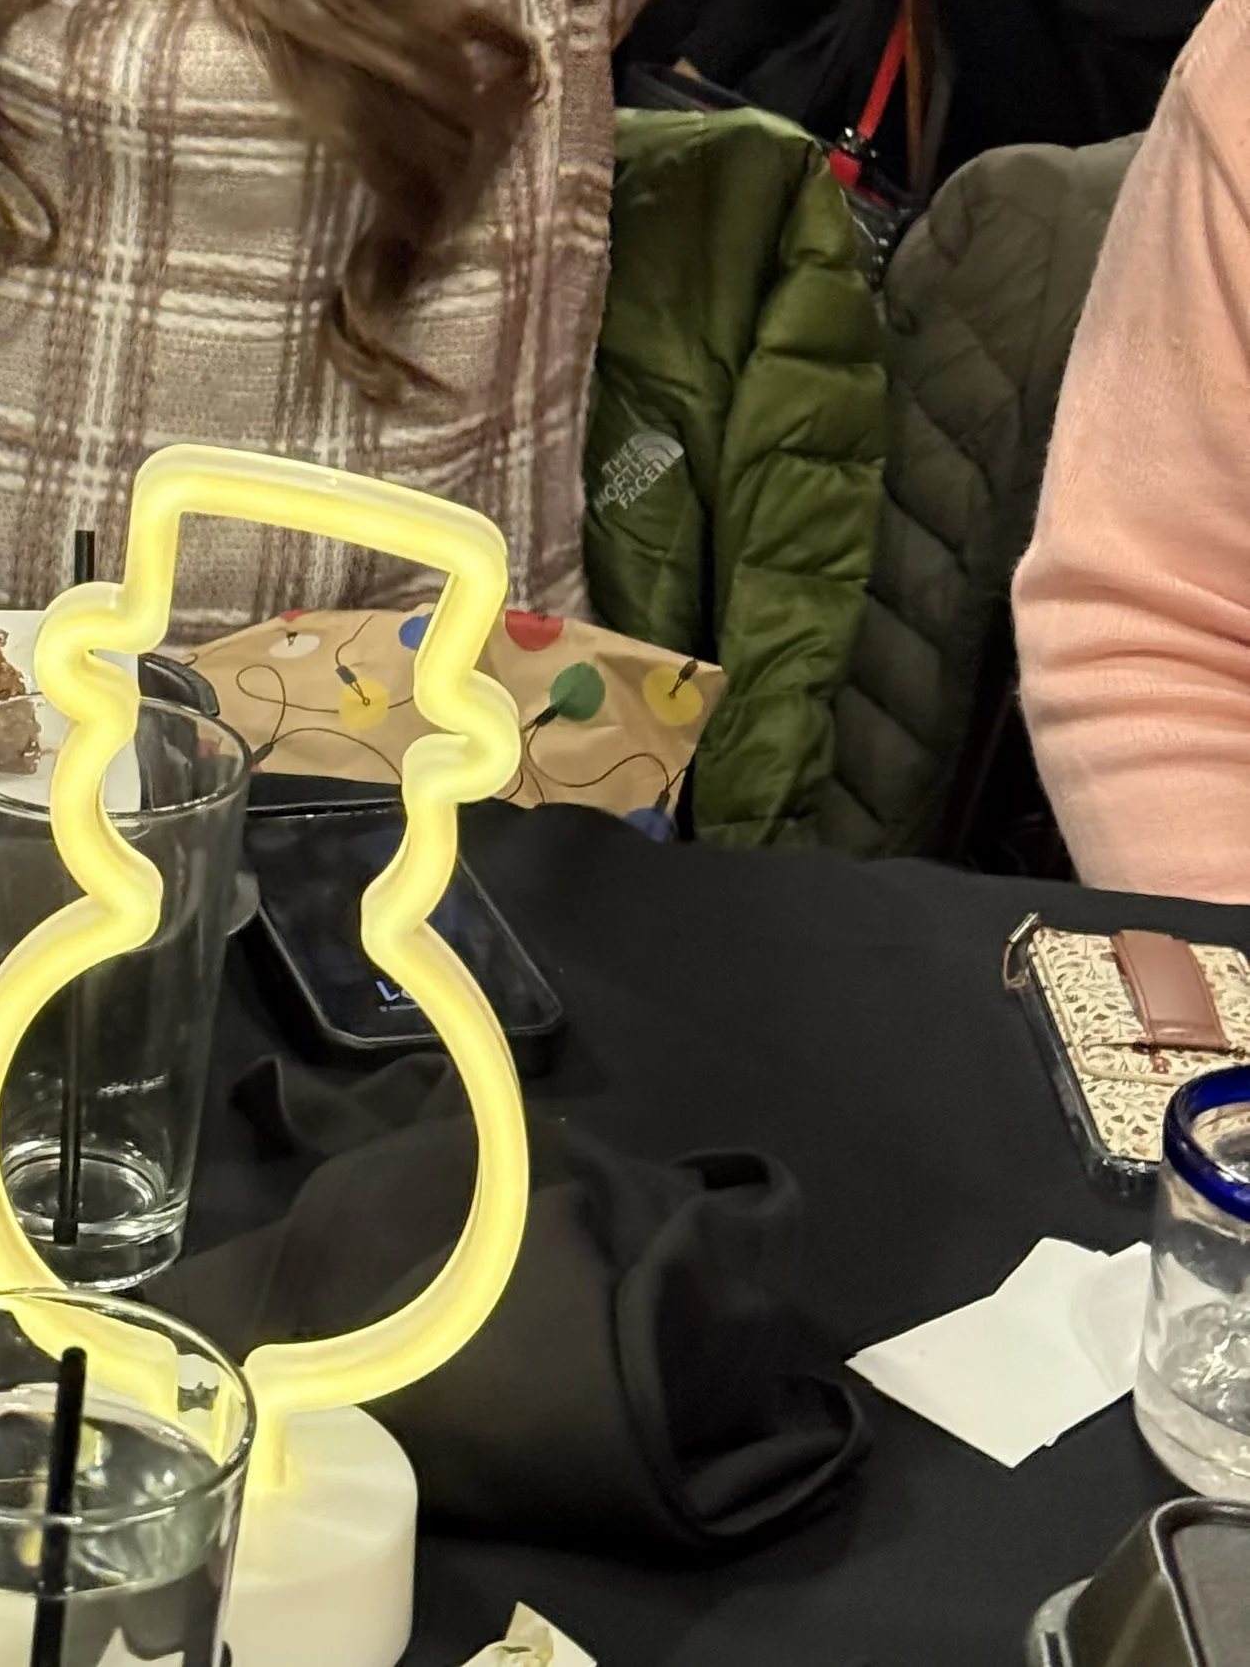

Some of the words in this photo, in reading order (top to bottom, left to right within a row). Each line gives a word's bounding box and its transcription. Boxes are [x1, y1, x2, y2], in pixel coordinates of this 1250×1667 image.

[601, 440, 637, 477] THE
[593, 451, 650, 512] NORTH
[618, 466, 661, 511] FACE
